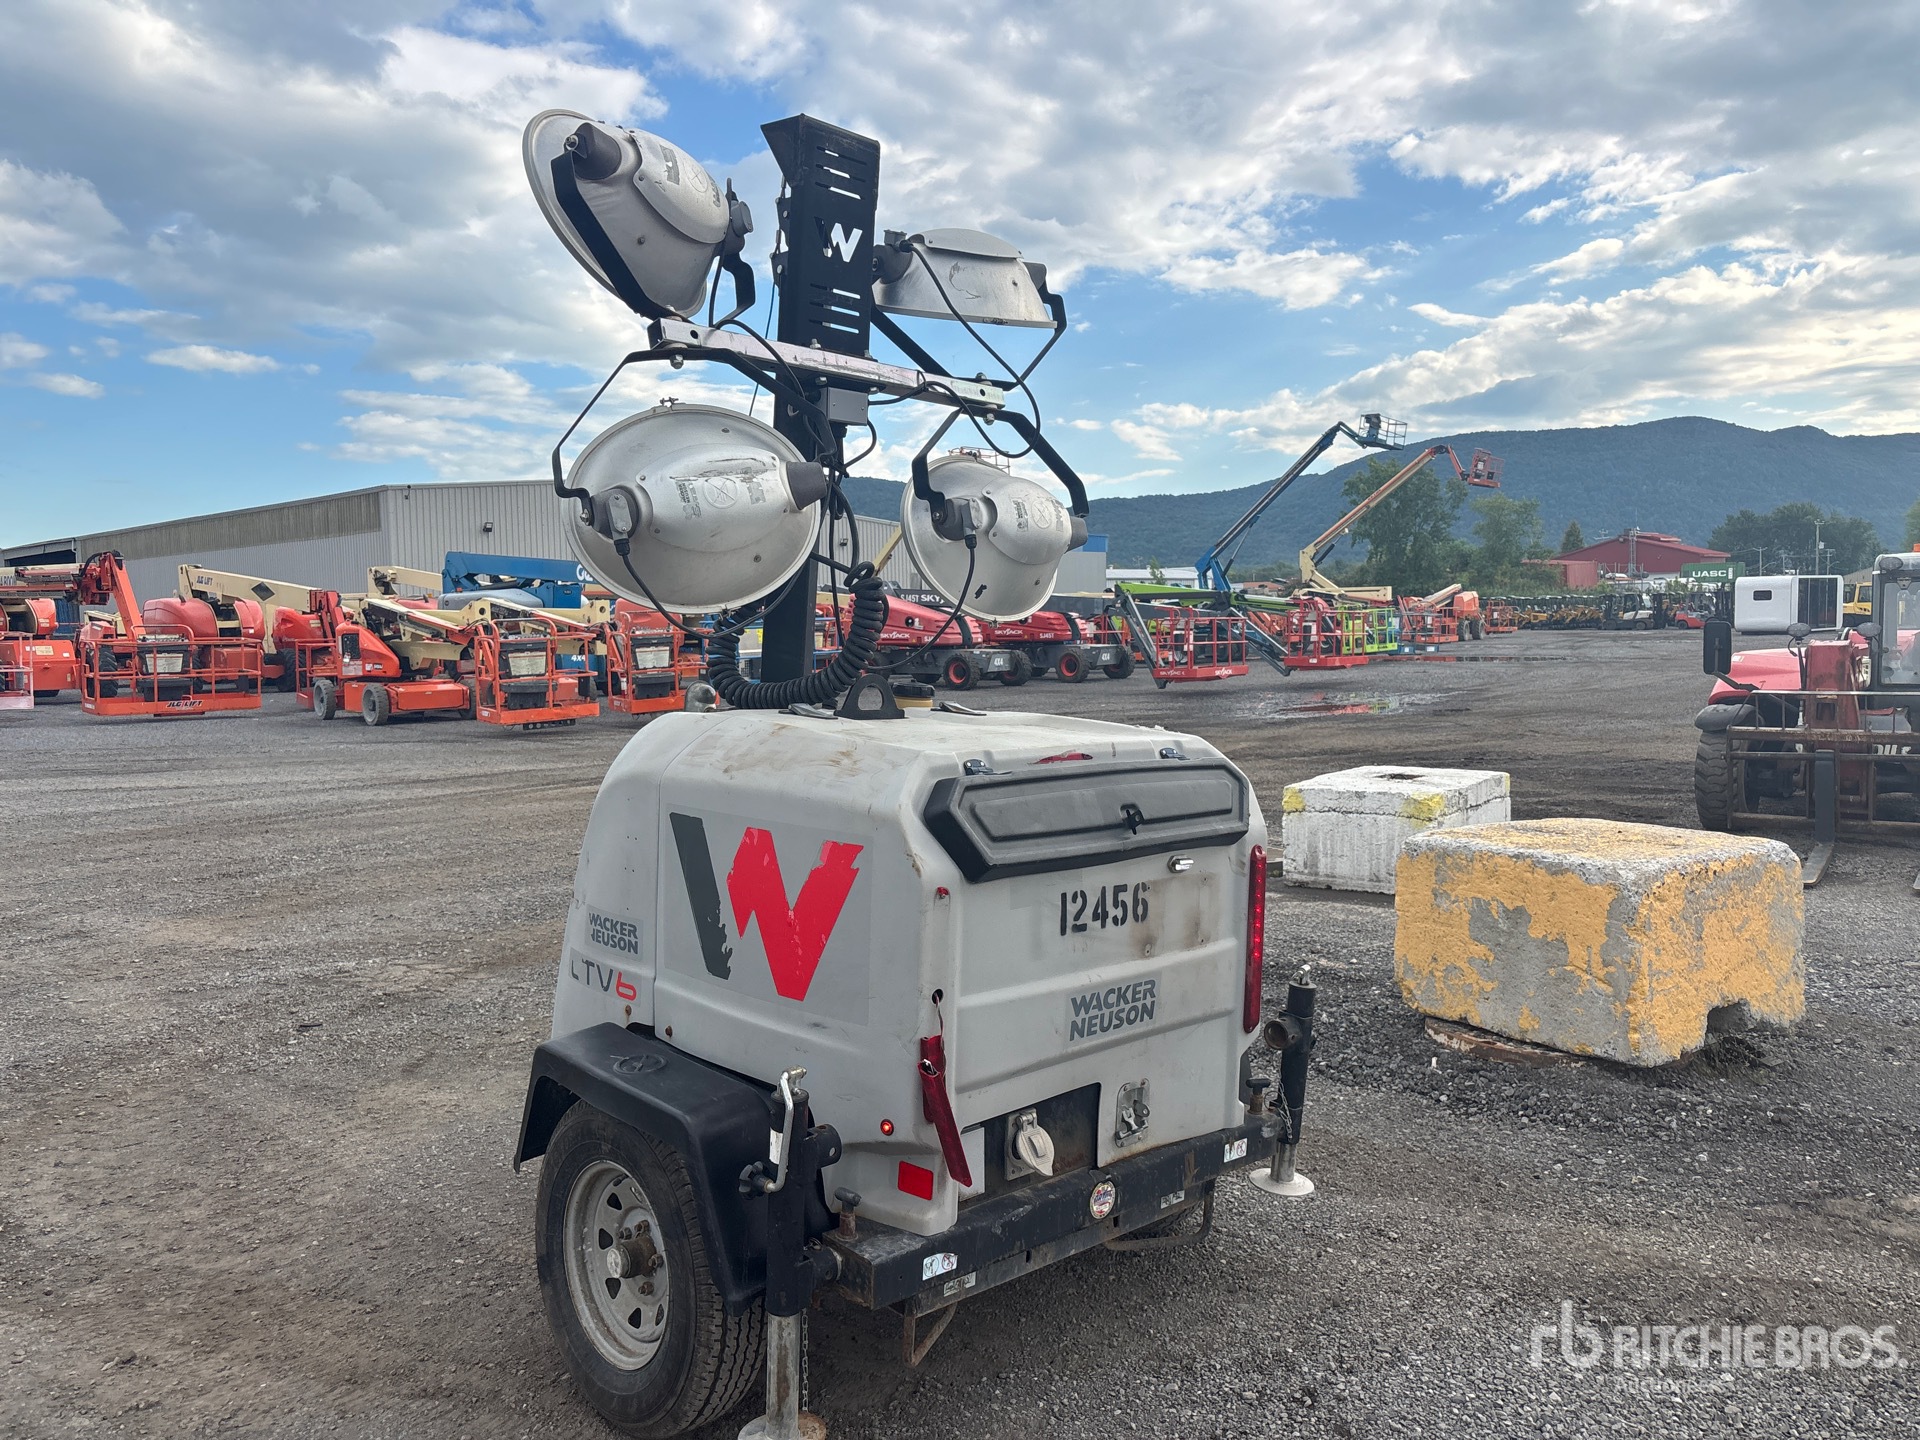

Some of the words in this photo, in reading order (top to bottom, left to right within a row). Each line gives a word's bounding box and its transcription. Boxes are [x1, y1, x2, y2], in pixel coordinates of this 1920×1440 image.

[1692, 570, 1727, 578] UASC
[920, 594, 946, 604] SKY
[880, 631, 910, 639] SKYJACK
[1215, 667, 1233, 676] SKYJACK
[1060, 881, 1149, 936] 12456
[588, 912, 639, 940] WACKER
[1070, 979, 1156, 1018] WACKER
[1069, 1000, 1156, 1042] NEUSON
